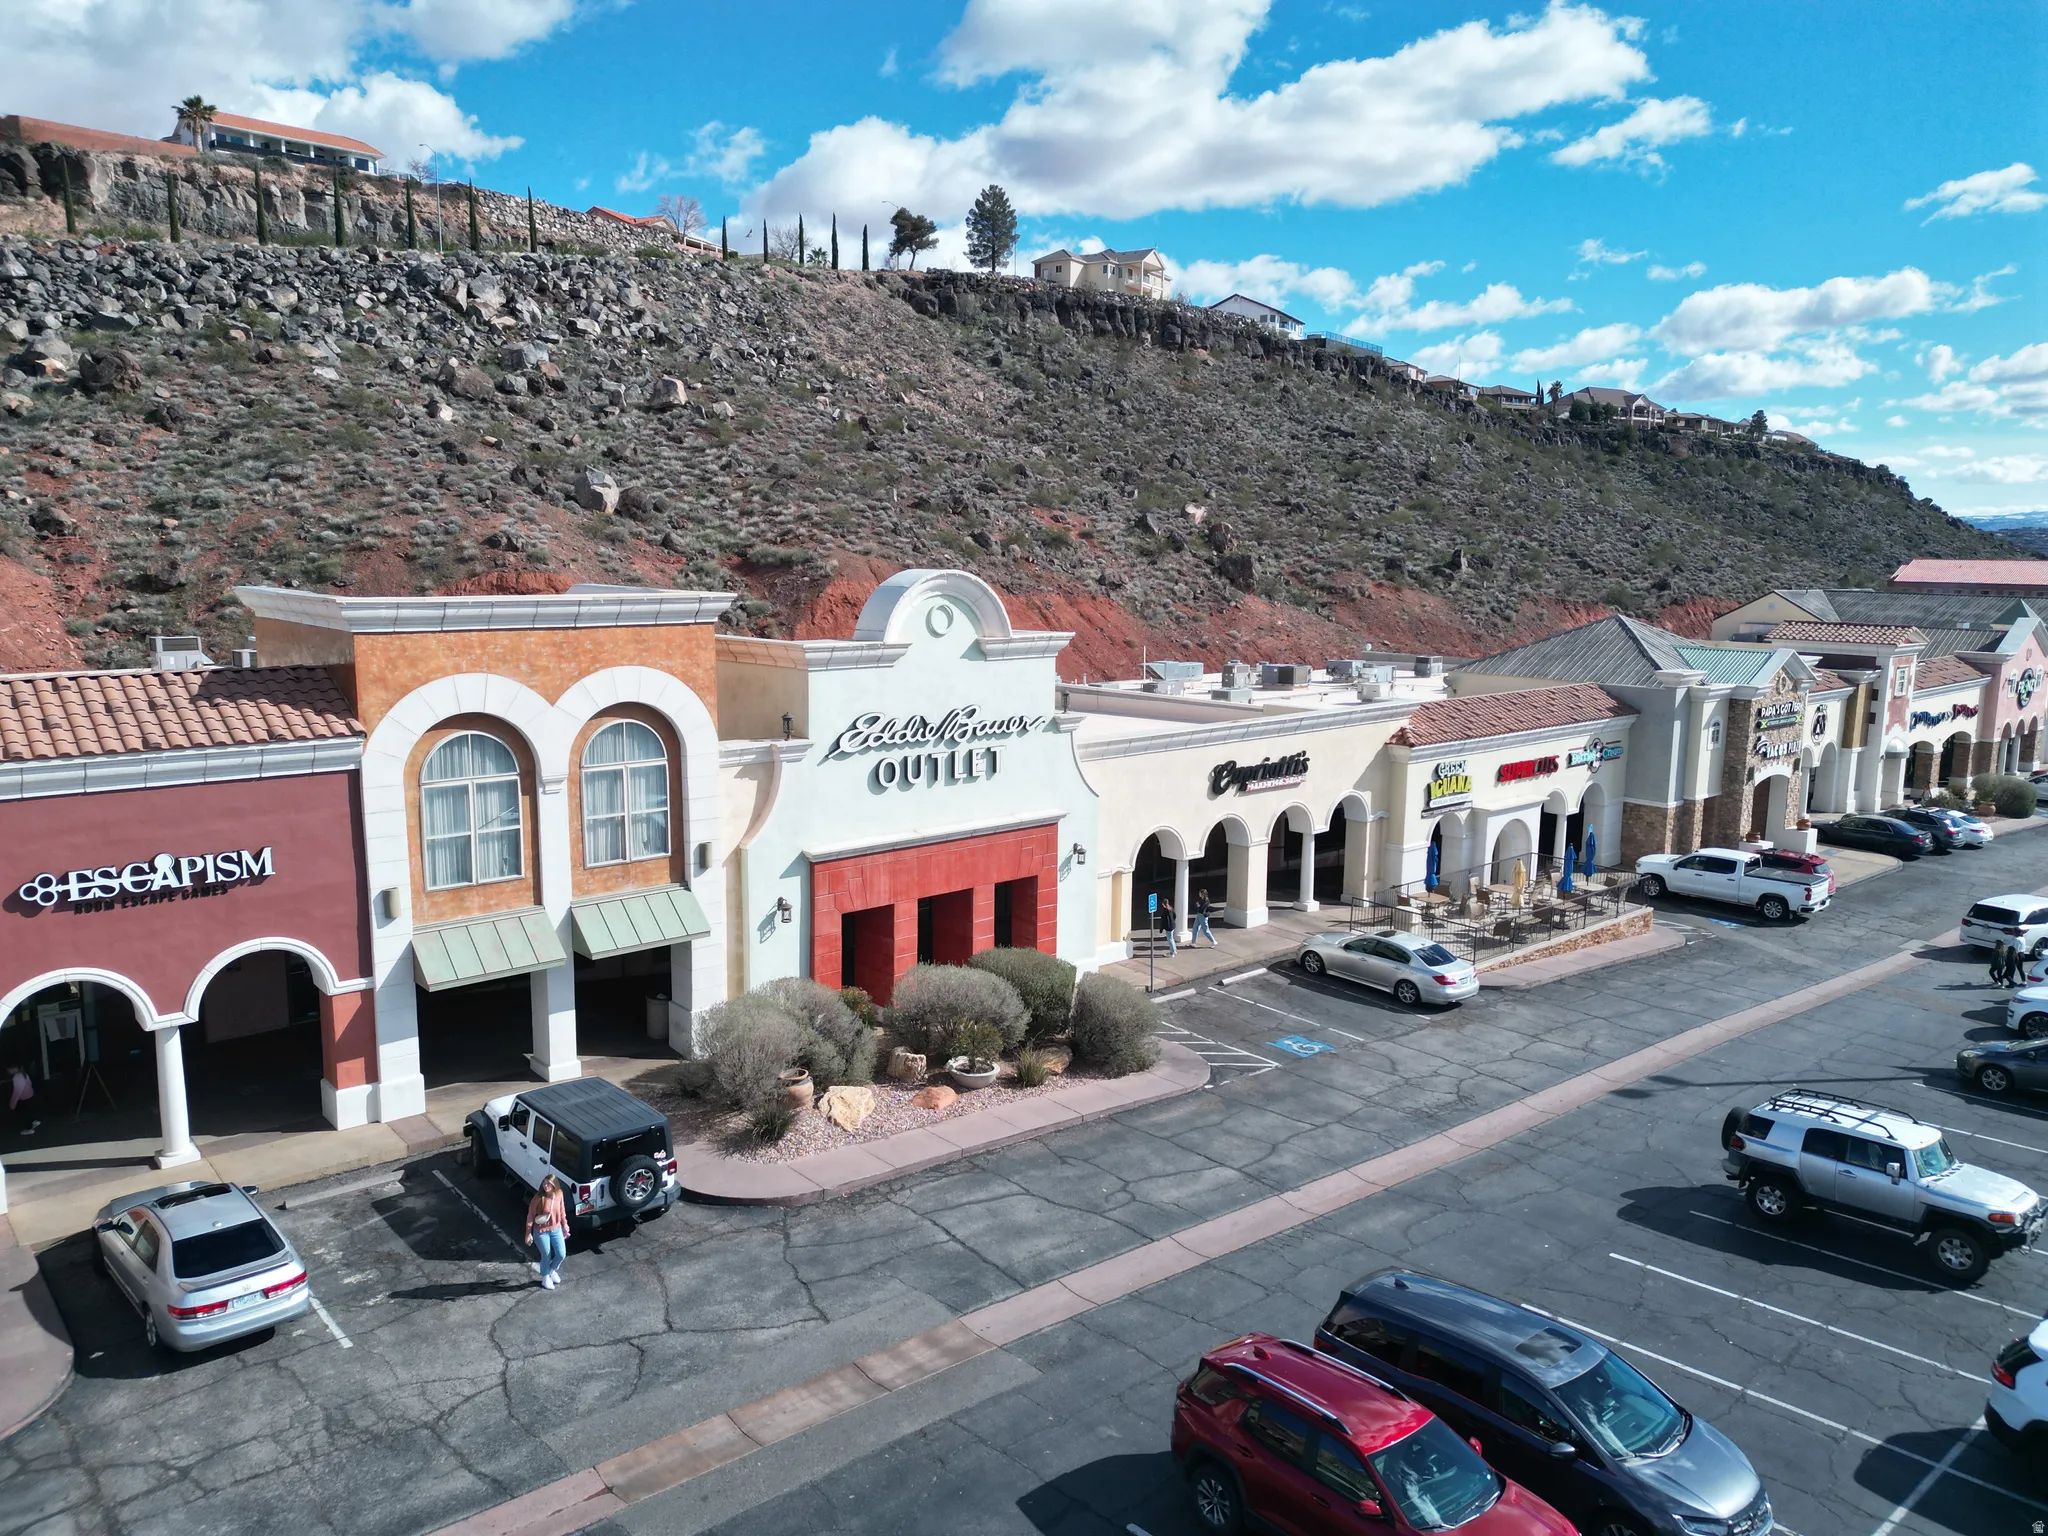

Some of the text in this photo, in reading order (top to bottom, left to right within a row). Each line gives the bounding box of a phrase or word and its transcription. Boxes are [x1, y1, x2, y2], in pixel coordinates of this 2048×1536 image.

[828, 704, 1047, 759] Eddie Bauer
[1766, 743, 1787, 759] TACOS
[876, 745, 1006, 788] OUTLET
[1436, 761, 1466, 779] GREEN
[1499, 755, 1559, 782] SUPERCUTS
[1429, 776, 1472, 800] IGUANA
[67, 847, 276, 902] ESCAPISM
[74, 883, 229, 915] ROOM ESCAPE GAMES
